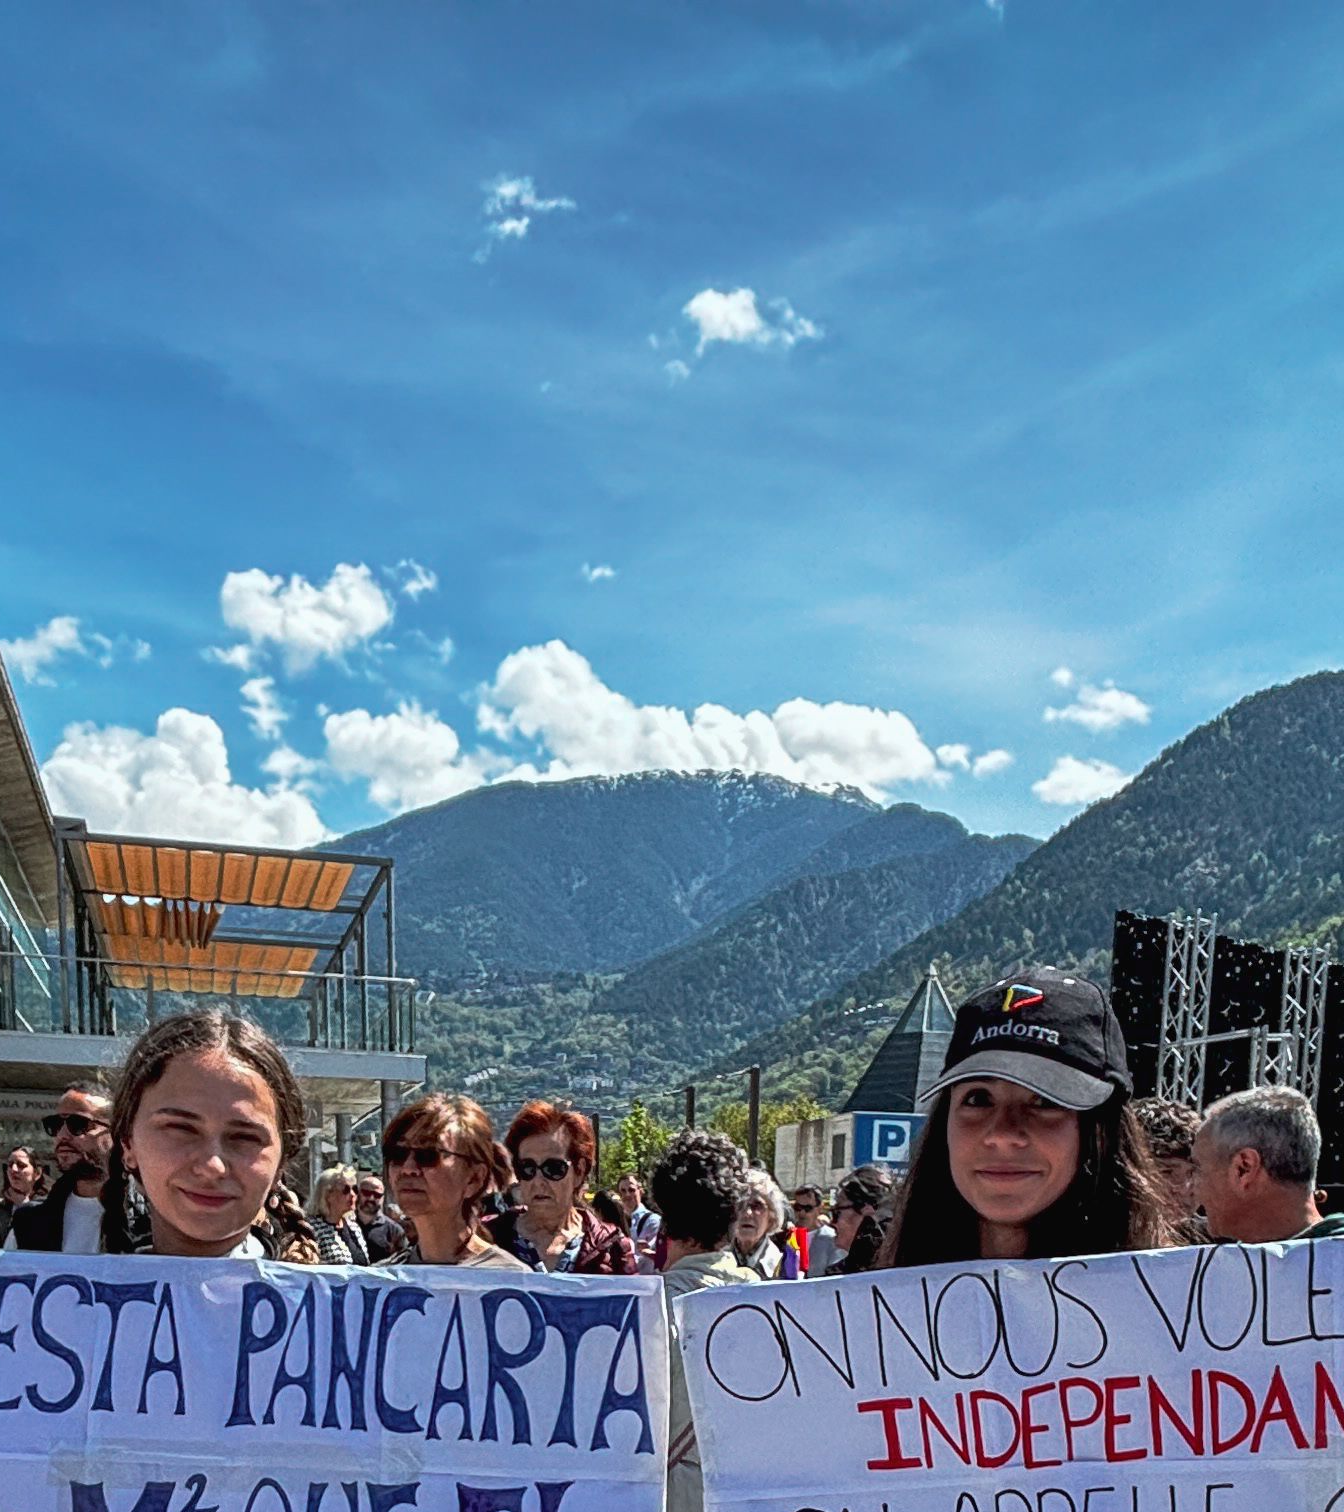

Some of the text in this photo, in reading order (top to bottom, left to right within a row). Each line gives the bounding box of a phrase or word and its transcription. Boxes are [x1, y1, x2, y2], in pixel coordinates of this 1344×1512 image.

[970, 1018, 1060, 1046] Andorra
[877, 1124, 907, 1158] P
[225, 1280, 655, 1456] PANCARTA
[704, 1294, 854, 1401] ON
[873, 1260, 1108, 1396] NOUS
